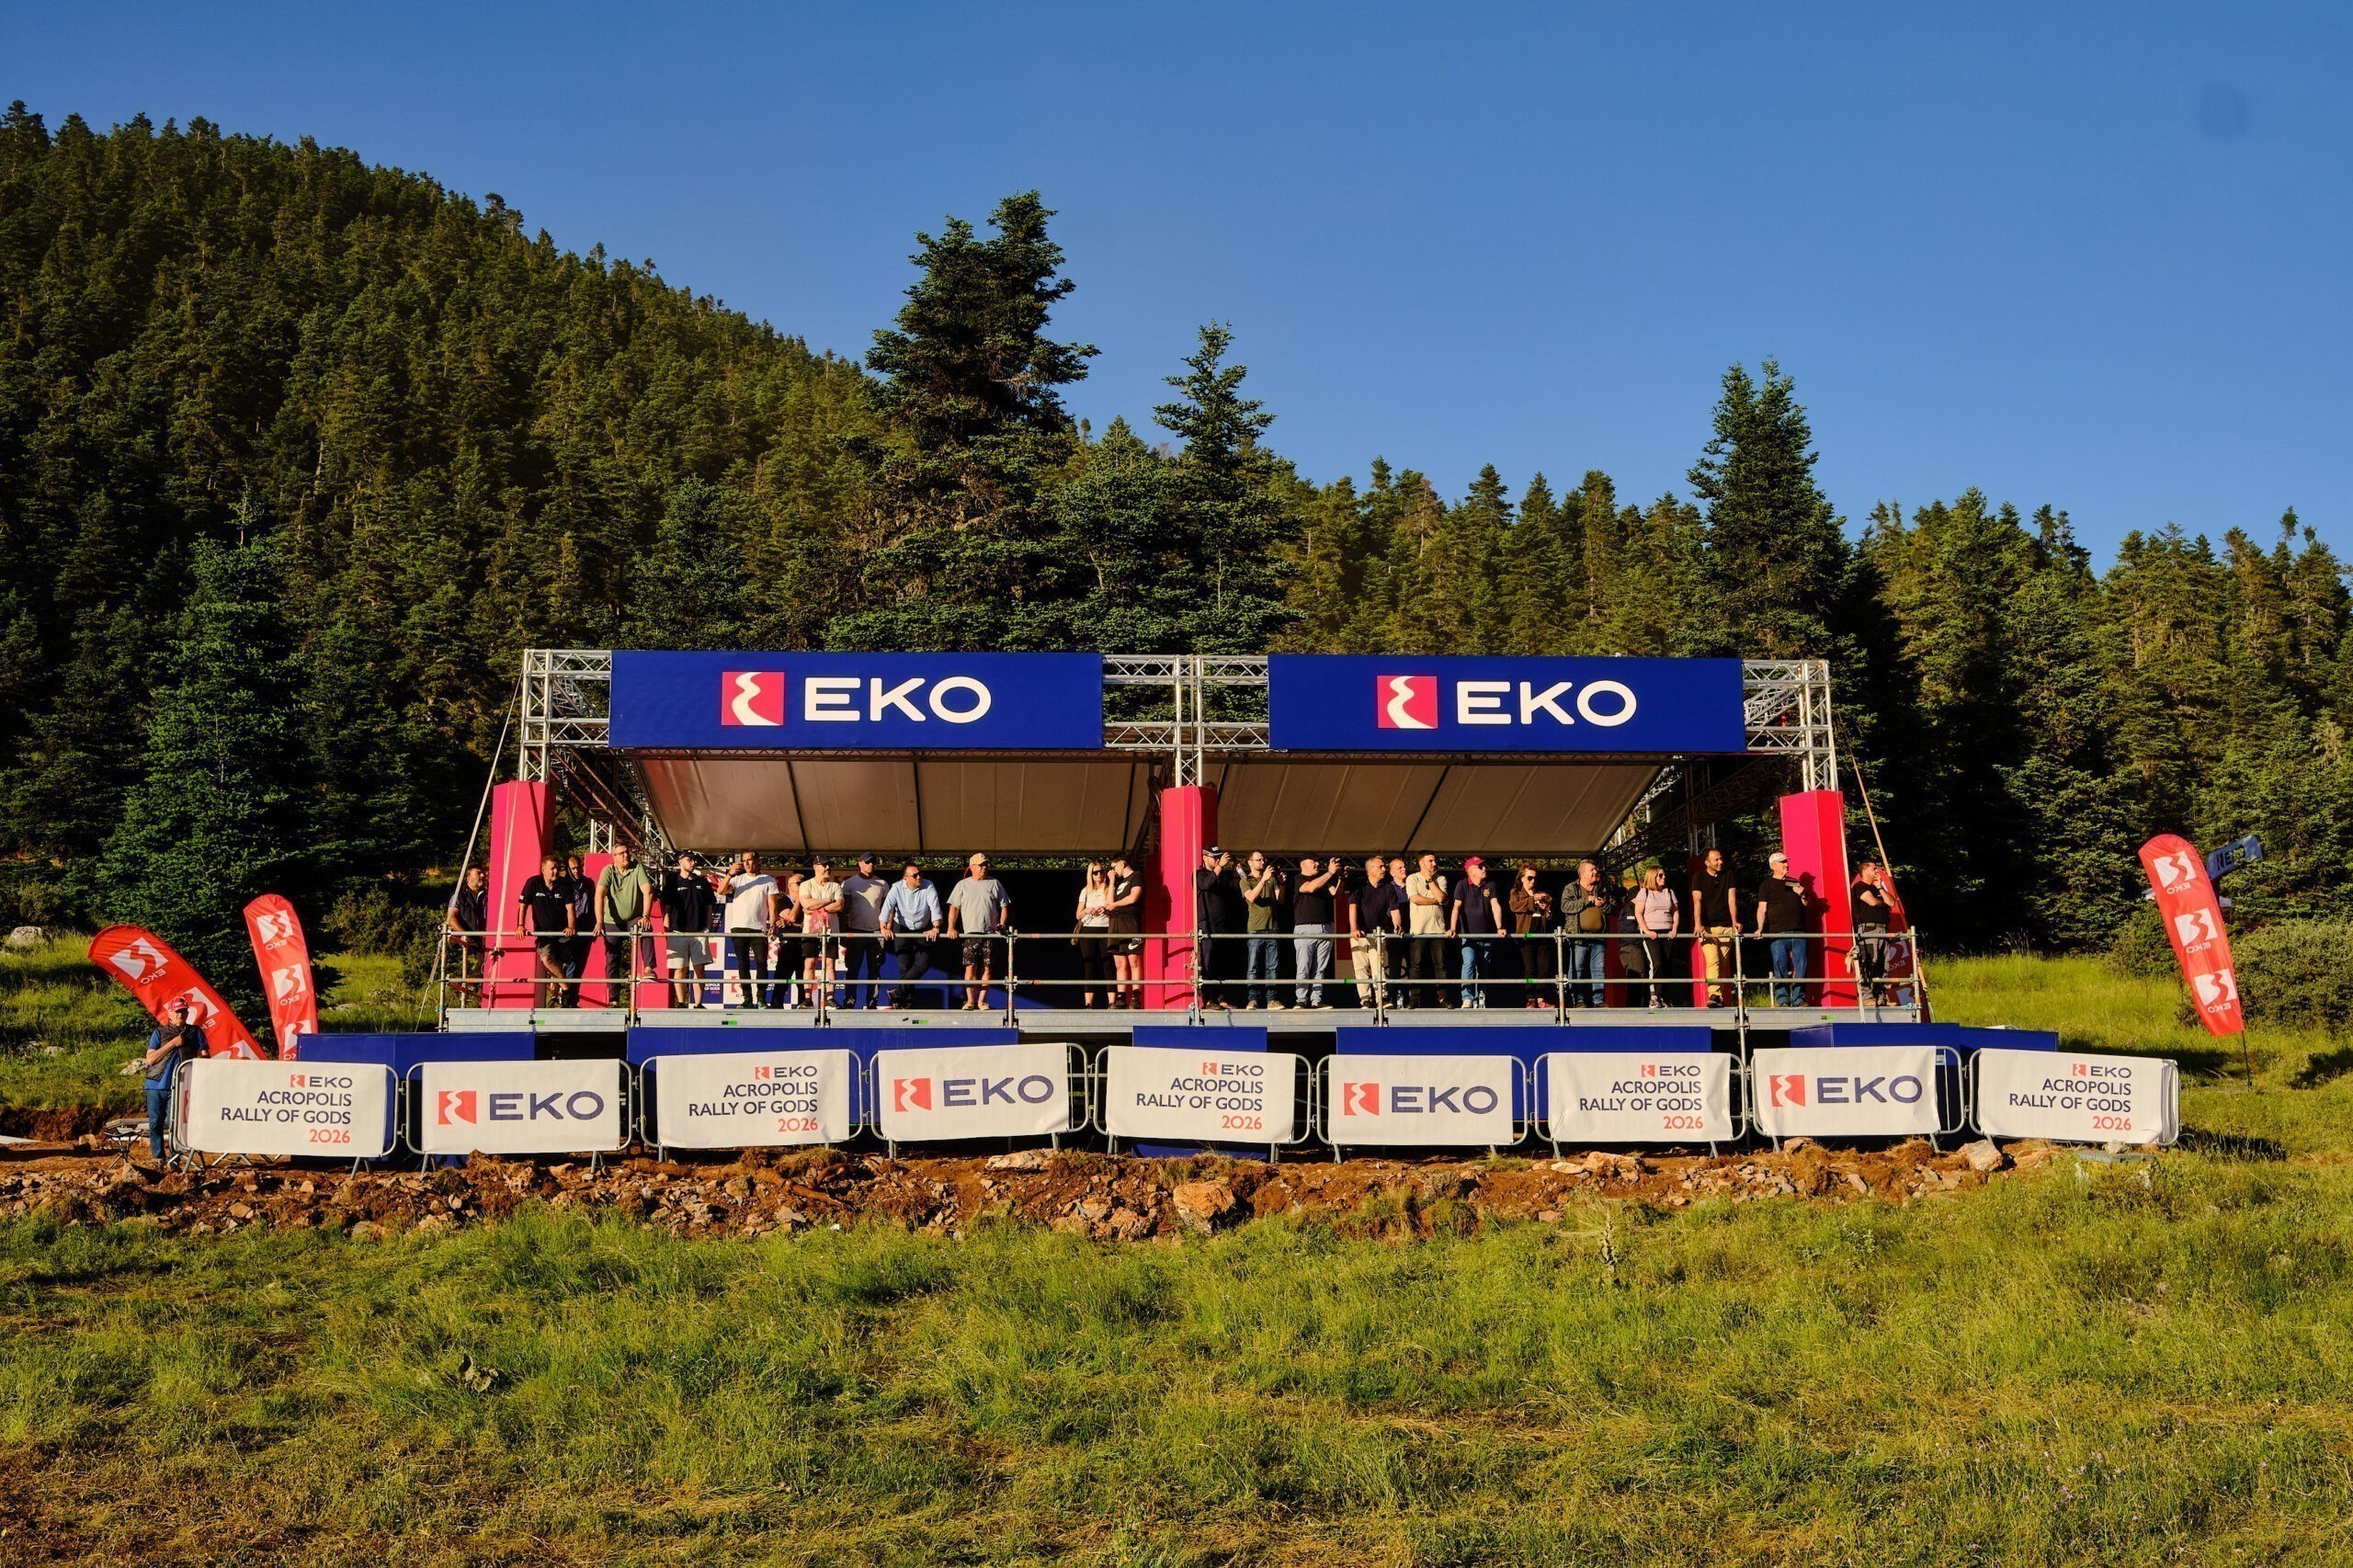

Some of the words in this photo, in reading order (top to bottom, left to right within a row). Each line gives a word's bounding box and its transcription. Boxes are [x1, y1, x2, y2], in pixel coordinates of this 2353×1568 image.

[804, 676, 992, 724] EKO
[1456, 679, 1637, 727] EKO
[774, 1065, 818, 1078] EKO
[1221, 1063, 1264, 1077] EKO
[1659, 1065, 1701, 1077] EKO
[2090, 1065, 2132, 1079] EKO
[309, 1076, 353, 1089] EKO
[722, 1081, 818, 1098] ACROPOLIS
[943, 1074, 1054, 1108] EKO
[1170, 1077, 1263, 1094] ACROPOLIS
[1610, 1080, 1701, 1094] ACROPOLIS
[1816, 1075, 1923, 1104] EKO
[2041, 1078, 2131, 1096] ACROPOLIS
[256, 1090, 352, 1107] ACROPOLIS
[489, 1090, 605, 1121] EKO
[1136, 1093, 1186, 1108] RALLY
[1188, 1096, 1211, 1109] OF
[1215, 1096, 1263, 1112] GODS
[1391, 1085, 1498, 1115] EKO
[1579, 1097, 1627, 1111] RALLY
[1630, 1097, 1653, 1111] OF
[1655, 1097, 1702, 1111] GODS
[2009, 1093, 2057, 1108] RALLY
[2060, 1096, 2083, 1109] OF
[2086, 1097, 2131, 1113] GODS
[221, 1107, 273, 1122] RALLY
[276, 1108, 300, 1123] OF
[303, 1109, 351, 1125] GODS
[688, 1101, 739, 1117] RALLY
[743, 1100, 767, 1115] OF
[770, 1098, 818, 1114] GODS
[778, 1118, 819, 1133] 2026
[1222, 1115, 1263, 1131] 2026
[1663, 1115, 1703, 1130] 2026
[2092, 1115, 2131, 1131] 2026
[309, 1129, 351, 1144] 2026
